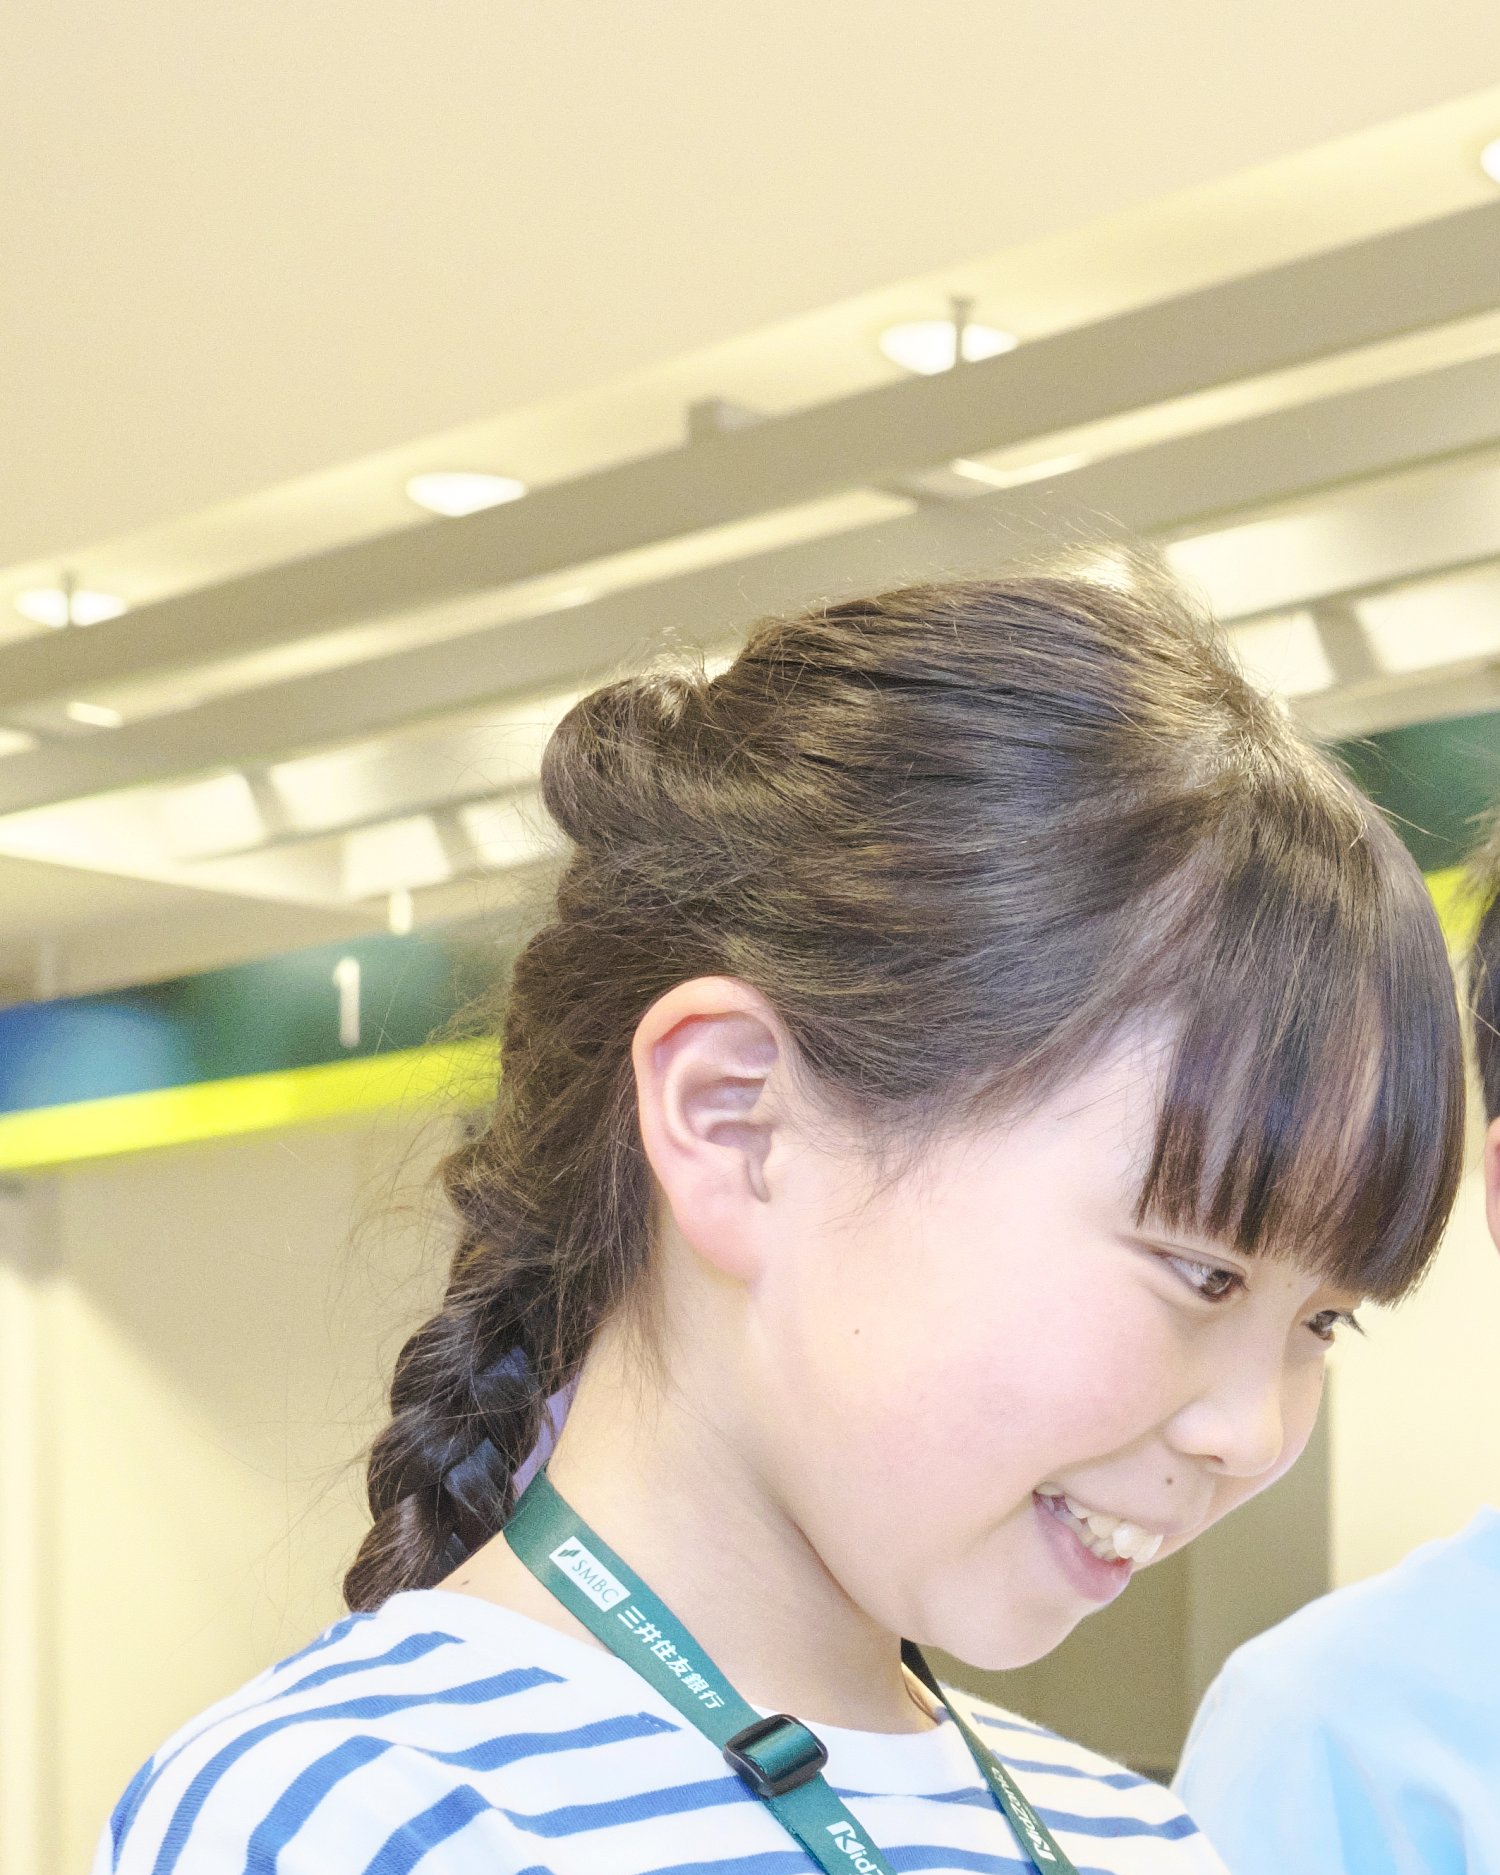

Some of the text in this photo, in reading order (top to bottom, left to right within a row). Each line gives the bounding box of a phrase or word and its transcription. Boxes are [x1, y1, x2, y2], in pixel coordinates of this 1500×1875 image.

[332, 956, 361, 1049] 1
[571, 1558, 725, 1709] SMBC 三井住友銀行
